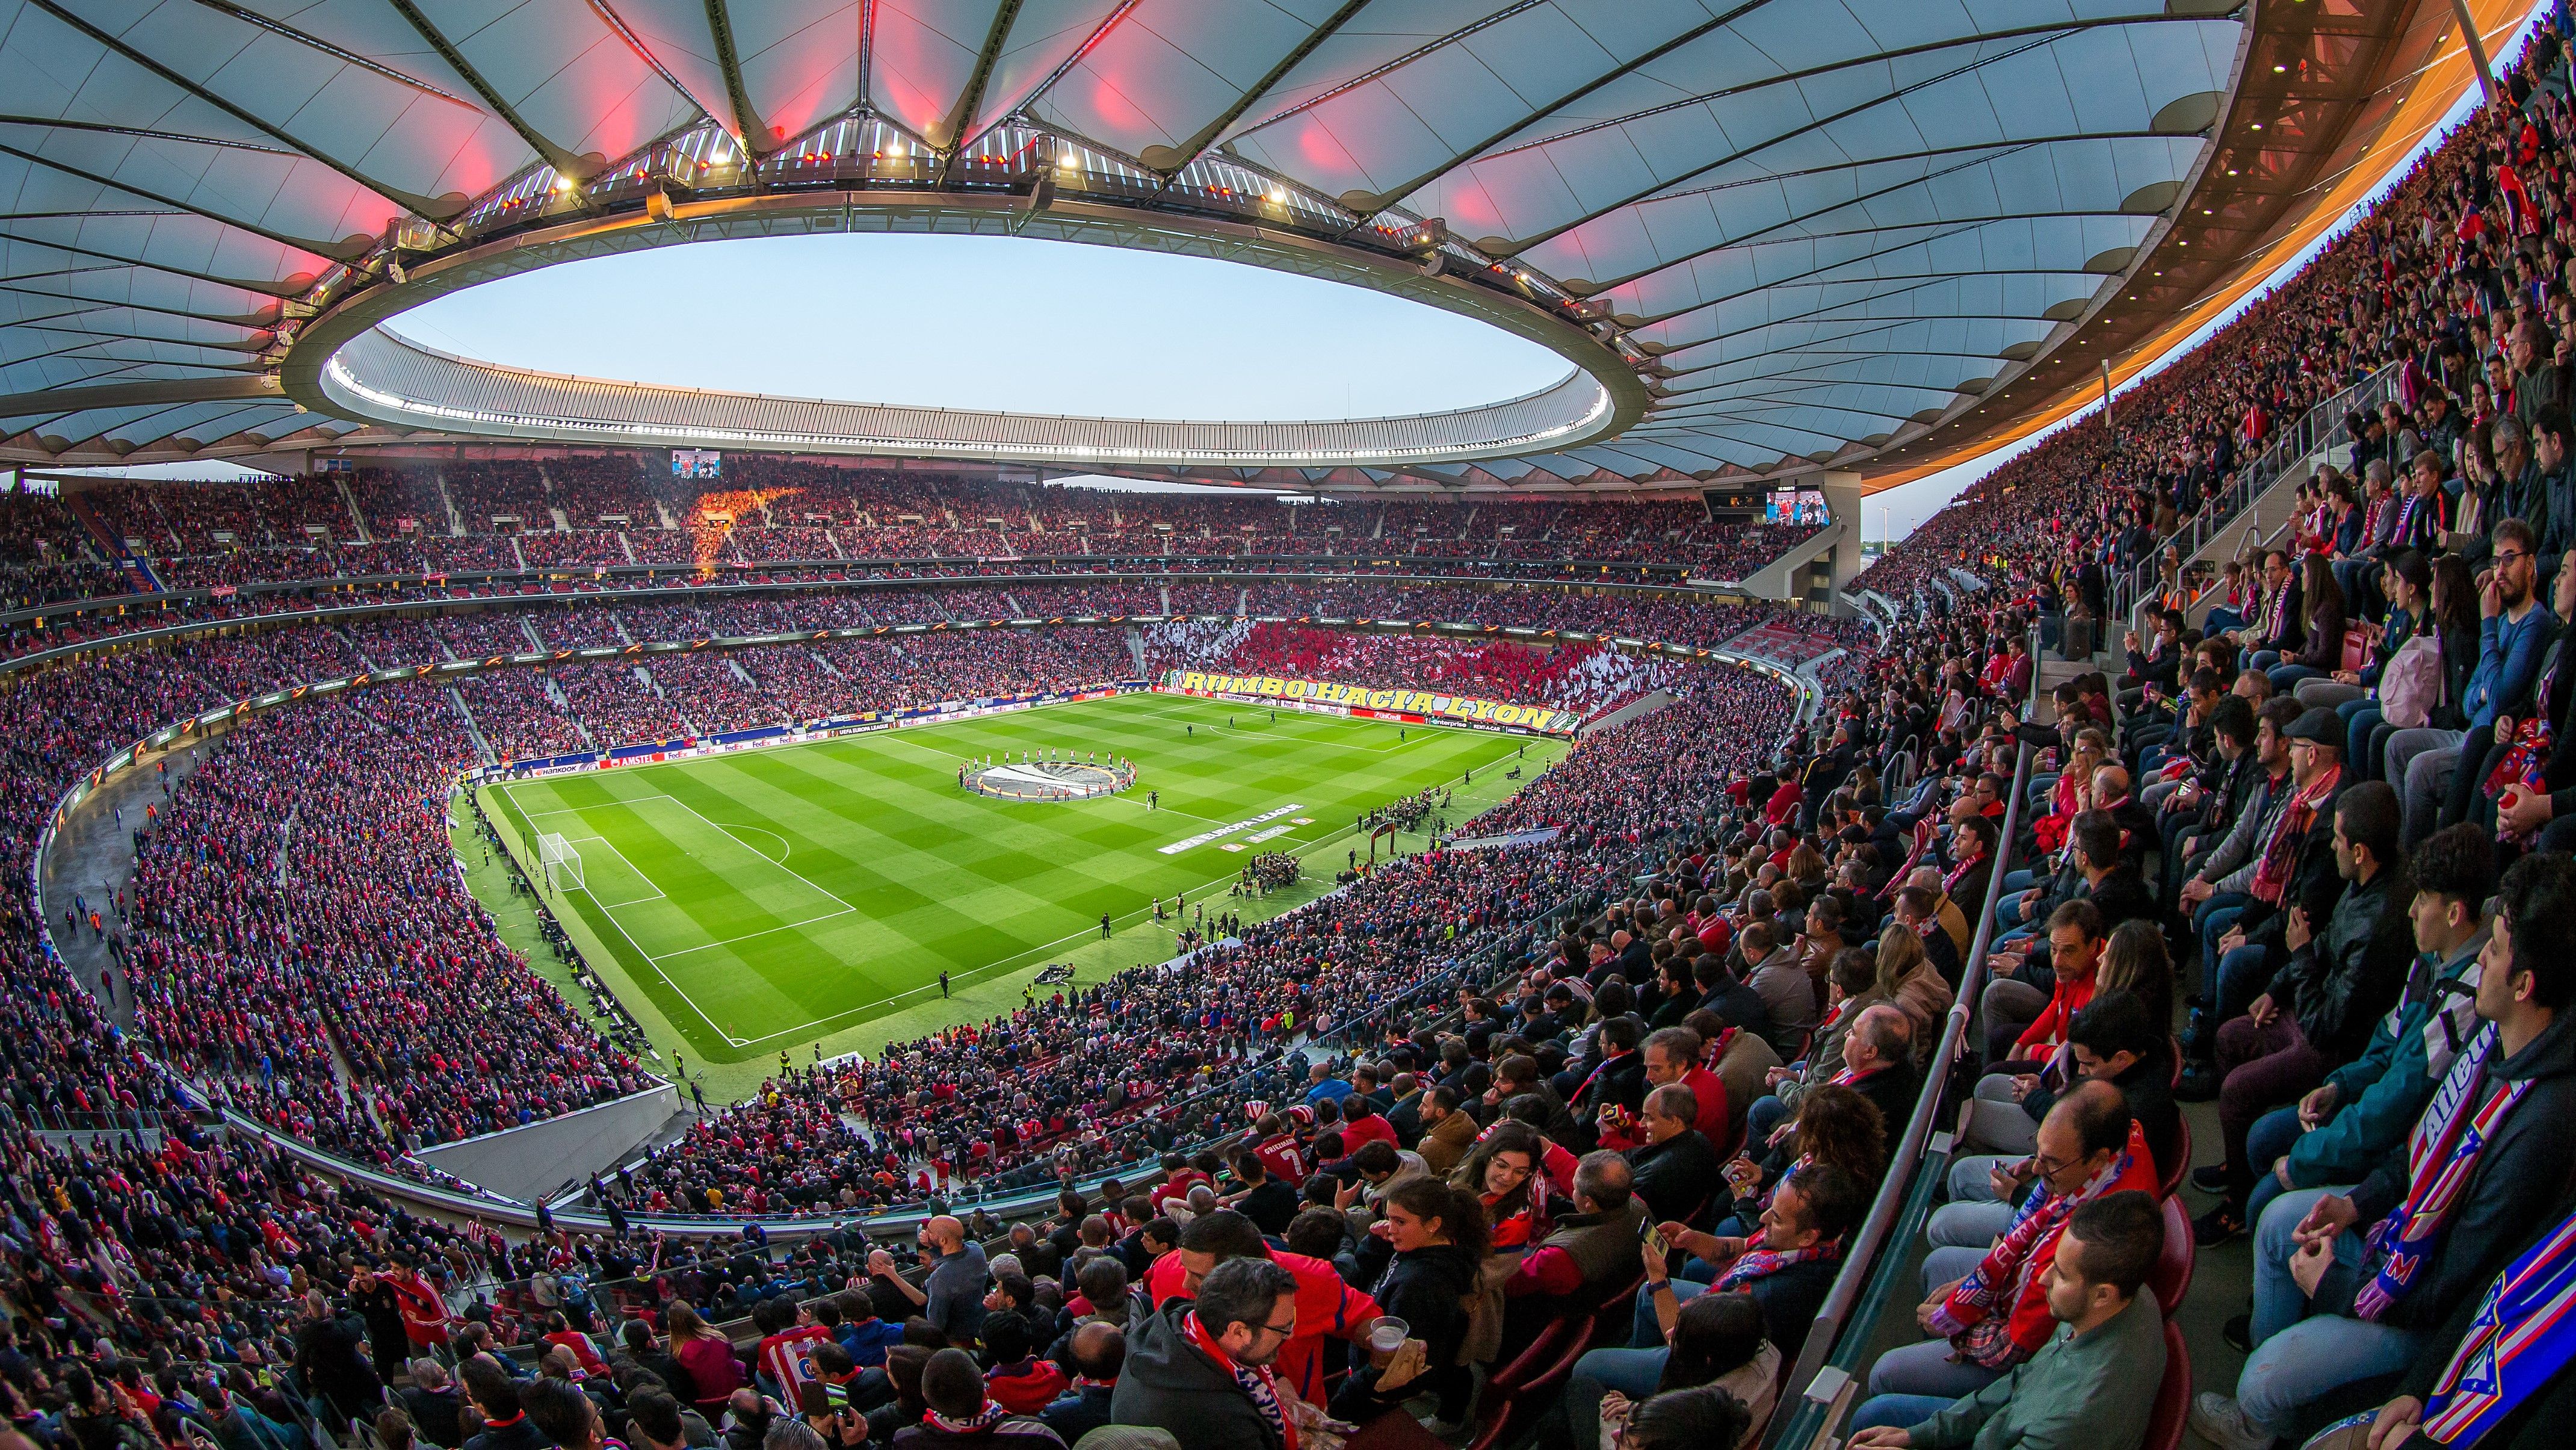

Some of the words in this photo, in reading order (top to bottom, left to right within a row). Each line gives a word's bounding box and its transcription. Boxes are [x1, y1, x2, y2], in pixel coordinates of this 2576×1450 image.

[1037, 696, 1069, 706] enterprise
[1181, 671, 1308, 698] RUMBO
[1312, 682, 1436, 713] HACIA
[1444, 696, 1555, 730] LYON
[1433, 719, 1467, 728] enterprise
[697, 748, 716, 756] FedEx
[725, 743, 743, 752] FedEx
[622, 754, 655, 766] AMSTEL
[669, 751, 688, 759] FedEx
[1162, 835, 1205, 854] UEFA
[1205, 818, 1258, 840] EUROPA
[1256, 804, 1304, 823] LEAGUE
[1280, 1148, 1303, 1176] 7
